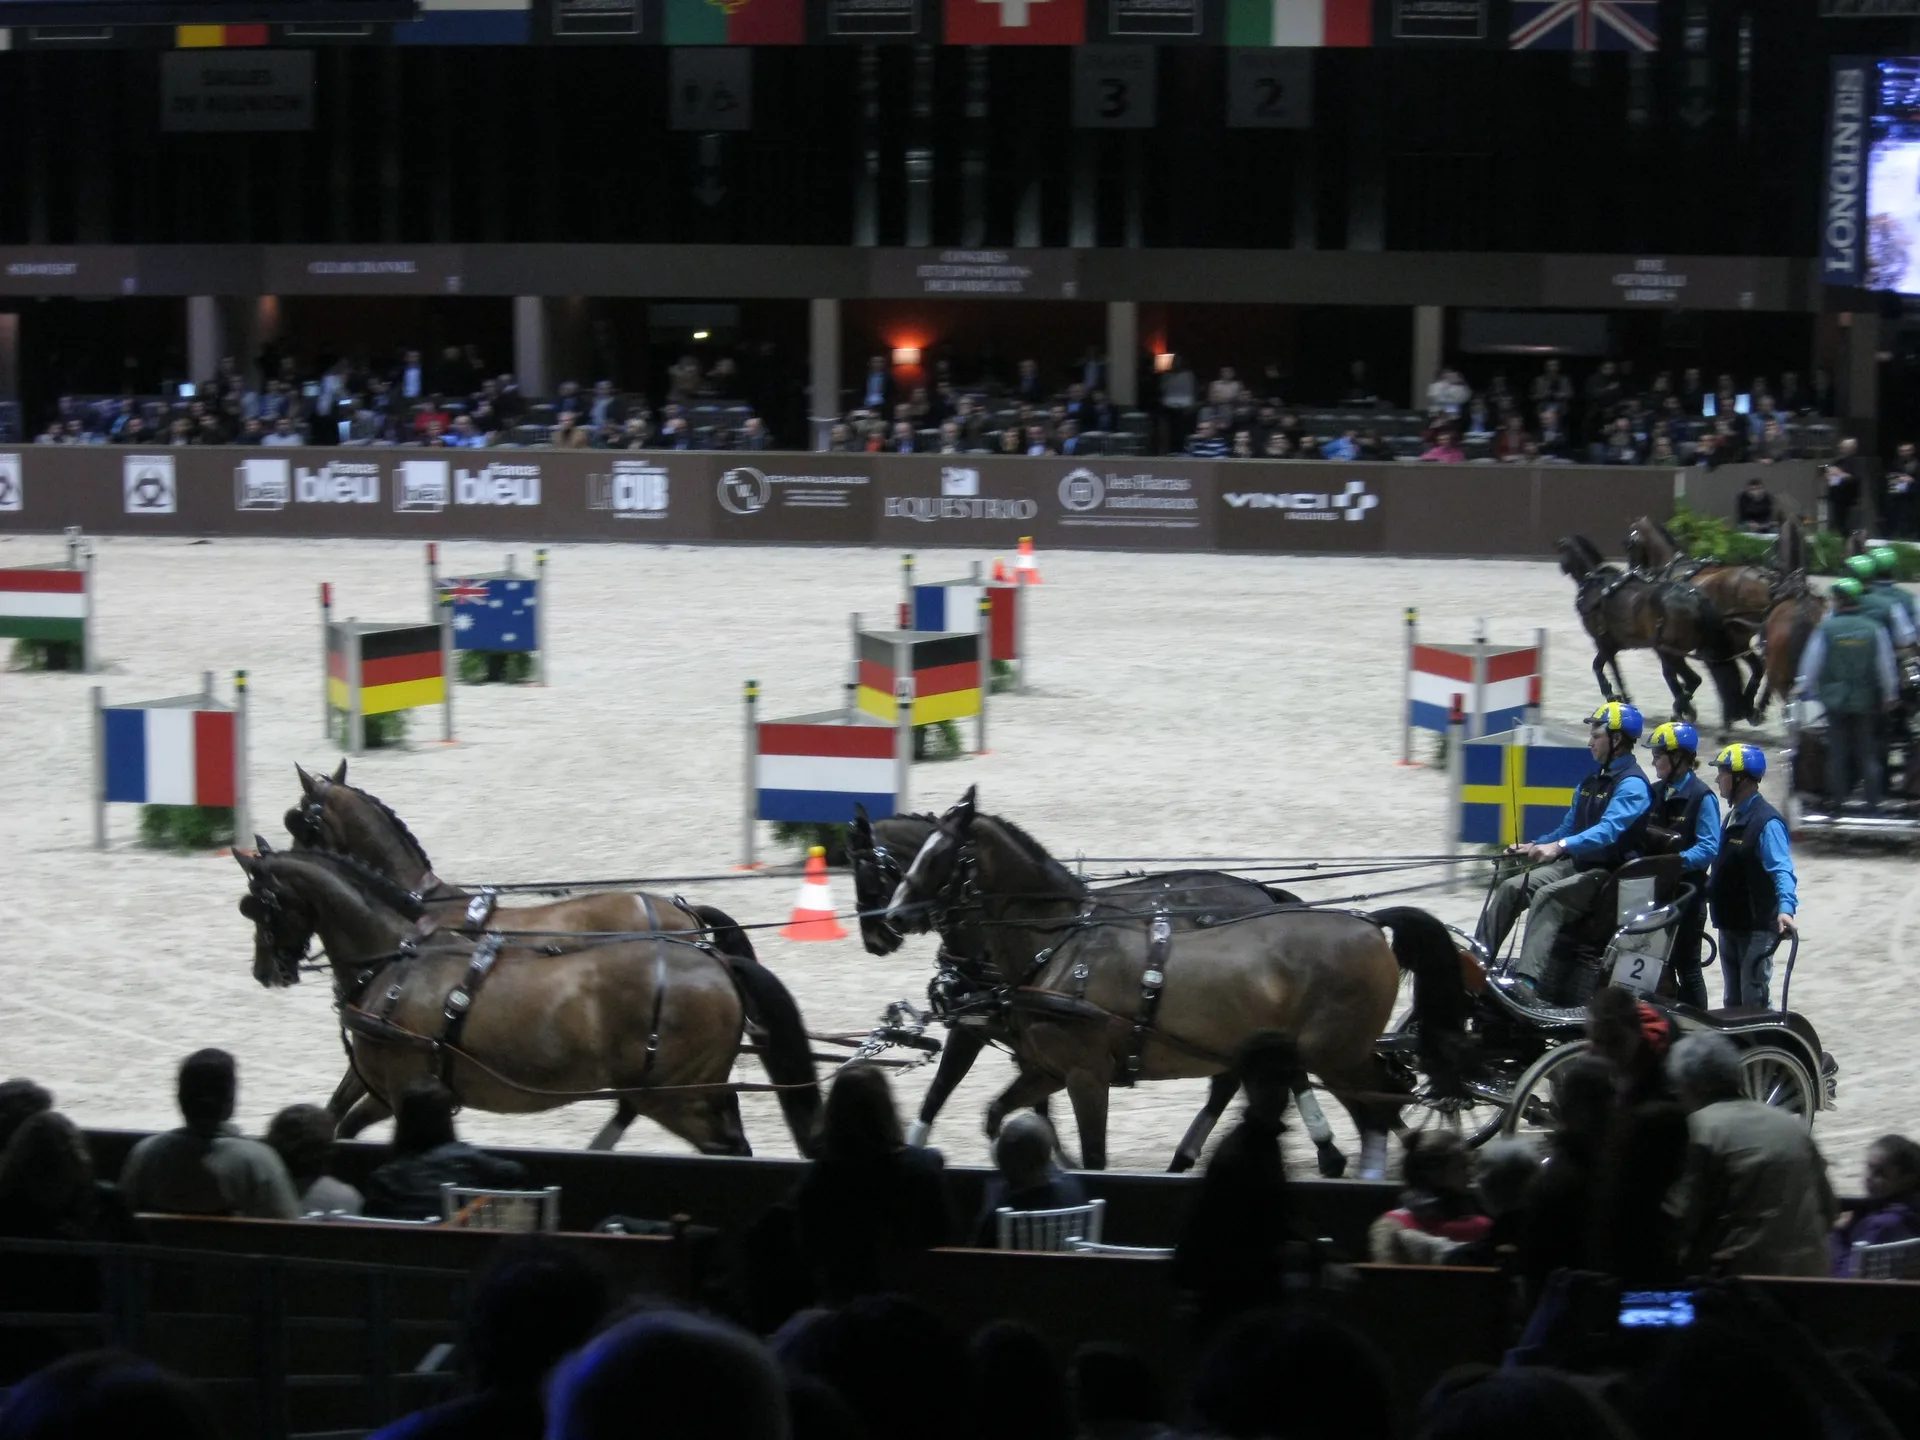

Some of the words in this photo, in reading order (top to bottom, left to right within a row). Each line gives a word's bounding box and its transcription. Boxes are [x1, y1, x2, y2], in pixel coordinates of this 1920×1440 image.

[1096, 77, 1129, 119] 3
[1253, 77, 1288, 118] 2
[1825, 68, 1865, 274] LONGINES
[294, 467, 381, 503] bleu
[453, 469, 542, 505] bleu
[1222, 492, 1330, 509] VINCI
[884, 496, 1039, 522] EQUESTRIO
[1629, 958, 1645, 980] 2
